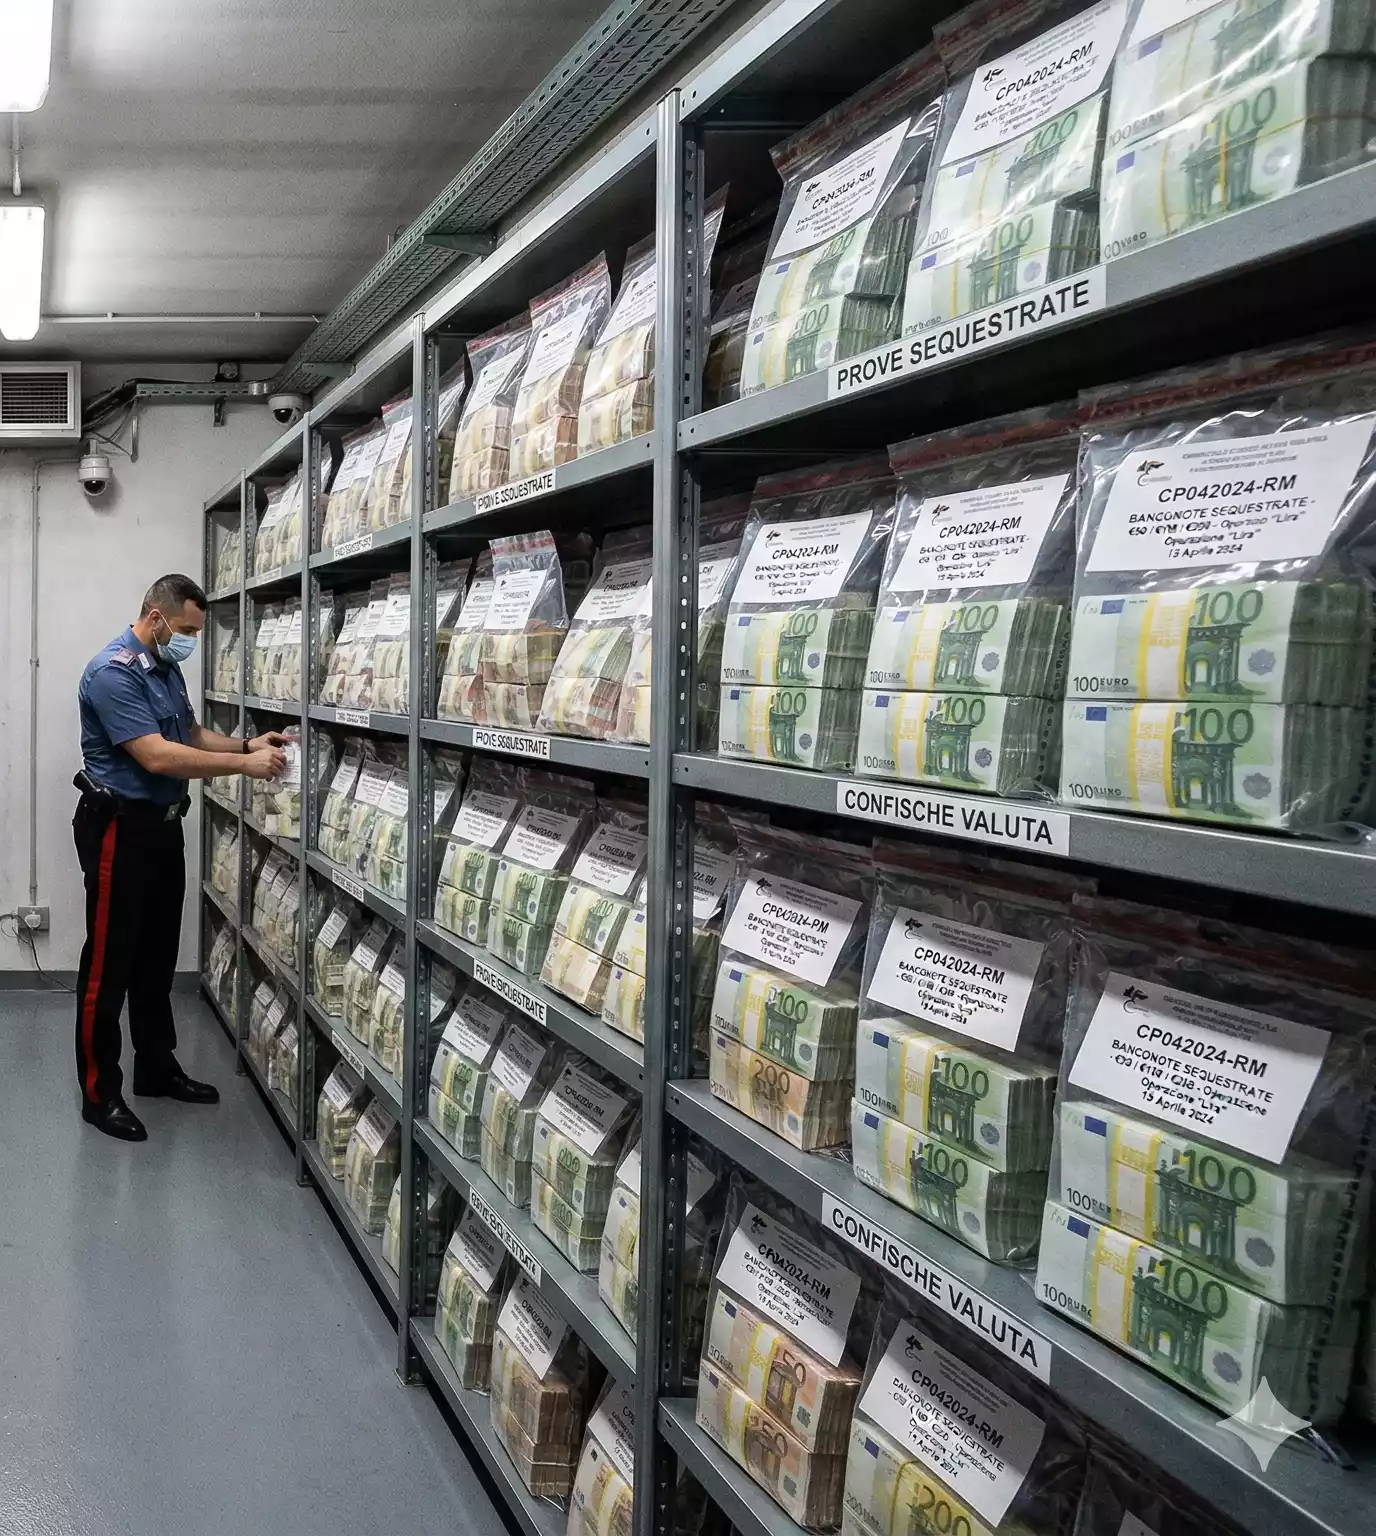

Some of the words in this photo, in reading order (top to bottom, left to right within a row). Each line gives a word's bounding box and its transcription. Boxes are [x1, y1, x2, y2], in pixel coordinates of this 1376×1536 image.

[1028, 110, 1079, 152] 100
[989, 214, 1035, 250] 100
[837, 347, 903, 390] PROVE
[910, 279, 1090, 365] SEQUESTRATE
[1158, 474, 1298, 503] CP042024-RM
[1128, 507, 1209, 524] BANCONOTE
[1211, 496, 1309, 518] SEQUESTRATE
[787, 613, 818, 637] 100
[955, 604, 999, 634] 100
[1195, 589, 1264, 626] 100
[1074, 677, 1099, 692] 100
[775, 692, 807, 715] 100
[945, 696, 986, 726] 100
[1185, 708, 1255, 744] 100
[1069, 783, 1094, 799] 100
[844, 790, 955, 828] CONFISCHE
[961, 807, 1054, 845] VALUTA
[914, 947, 1006, 985] CP042024-RM
[777, 991, 809, 1025] 100
[1136, 1024, 1269, 1078] CP042024-RM
[755, 1058, 790, 1096] 200
[941, 1056, 990, 1100] 100
[1111, 1039, 1182, 1071] BANCONOTE
[1184, 1064, 1274, 1103] SEQUESTRATE
[924, 1143, 968, 1189] 100
[1185, 1149, 1257, 1207] 100
[1067, 1187, 1092, 1212] 100
[832, 1207, 944, 1300] CONFISCHE
[948, 1284, 1039, 1368] VALUTA
[1043, 1282, 1068, 1309] 100
[1160, 1258, 1229, 1320] 100
[783, 1349, 808, 1389] 50
[911, 1369, 1005, 1449] CP042024-RM
